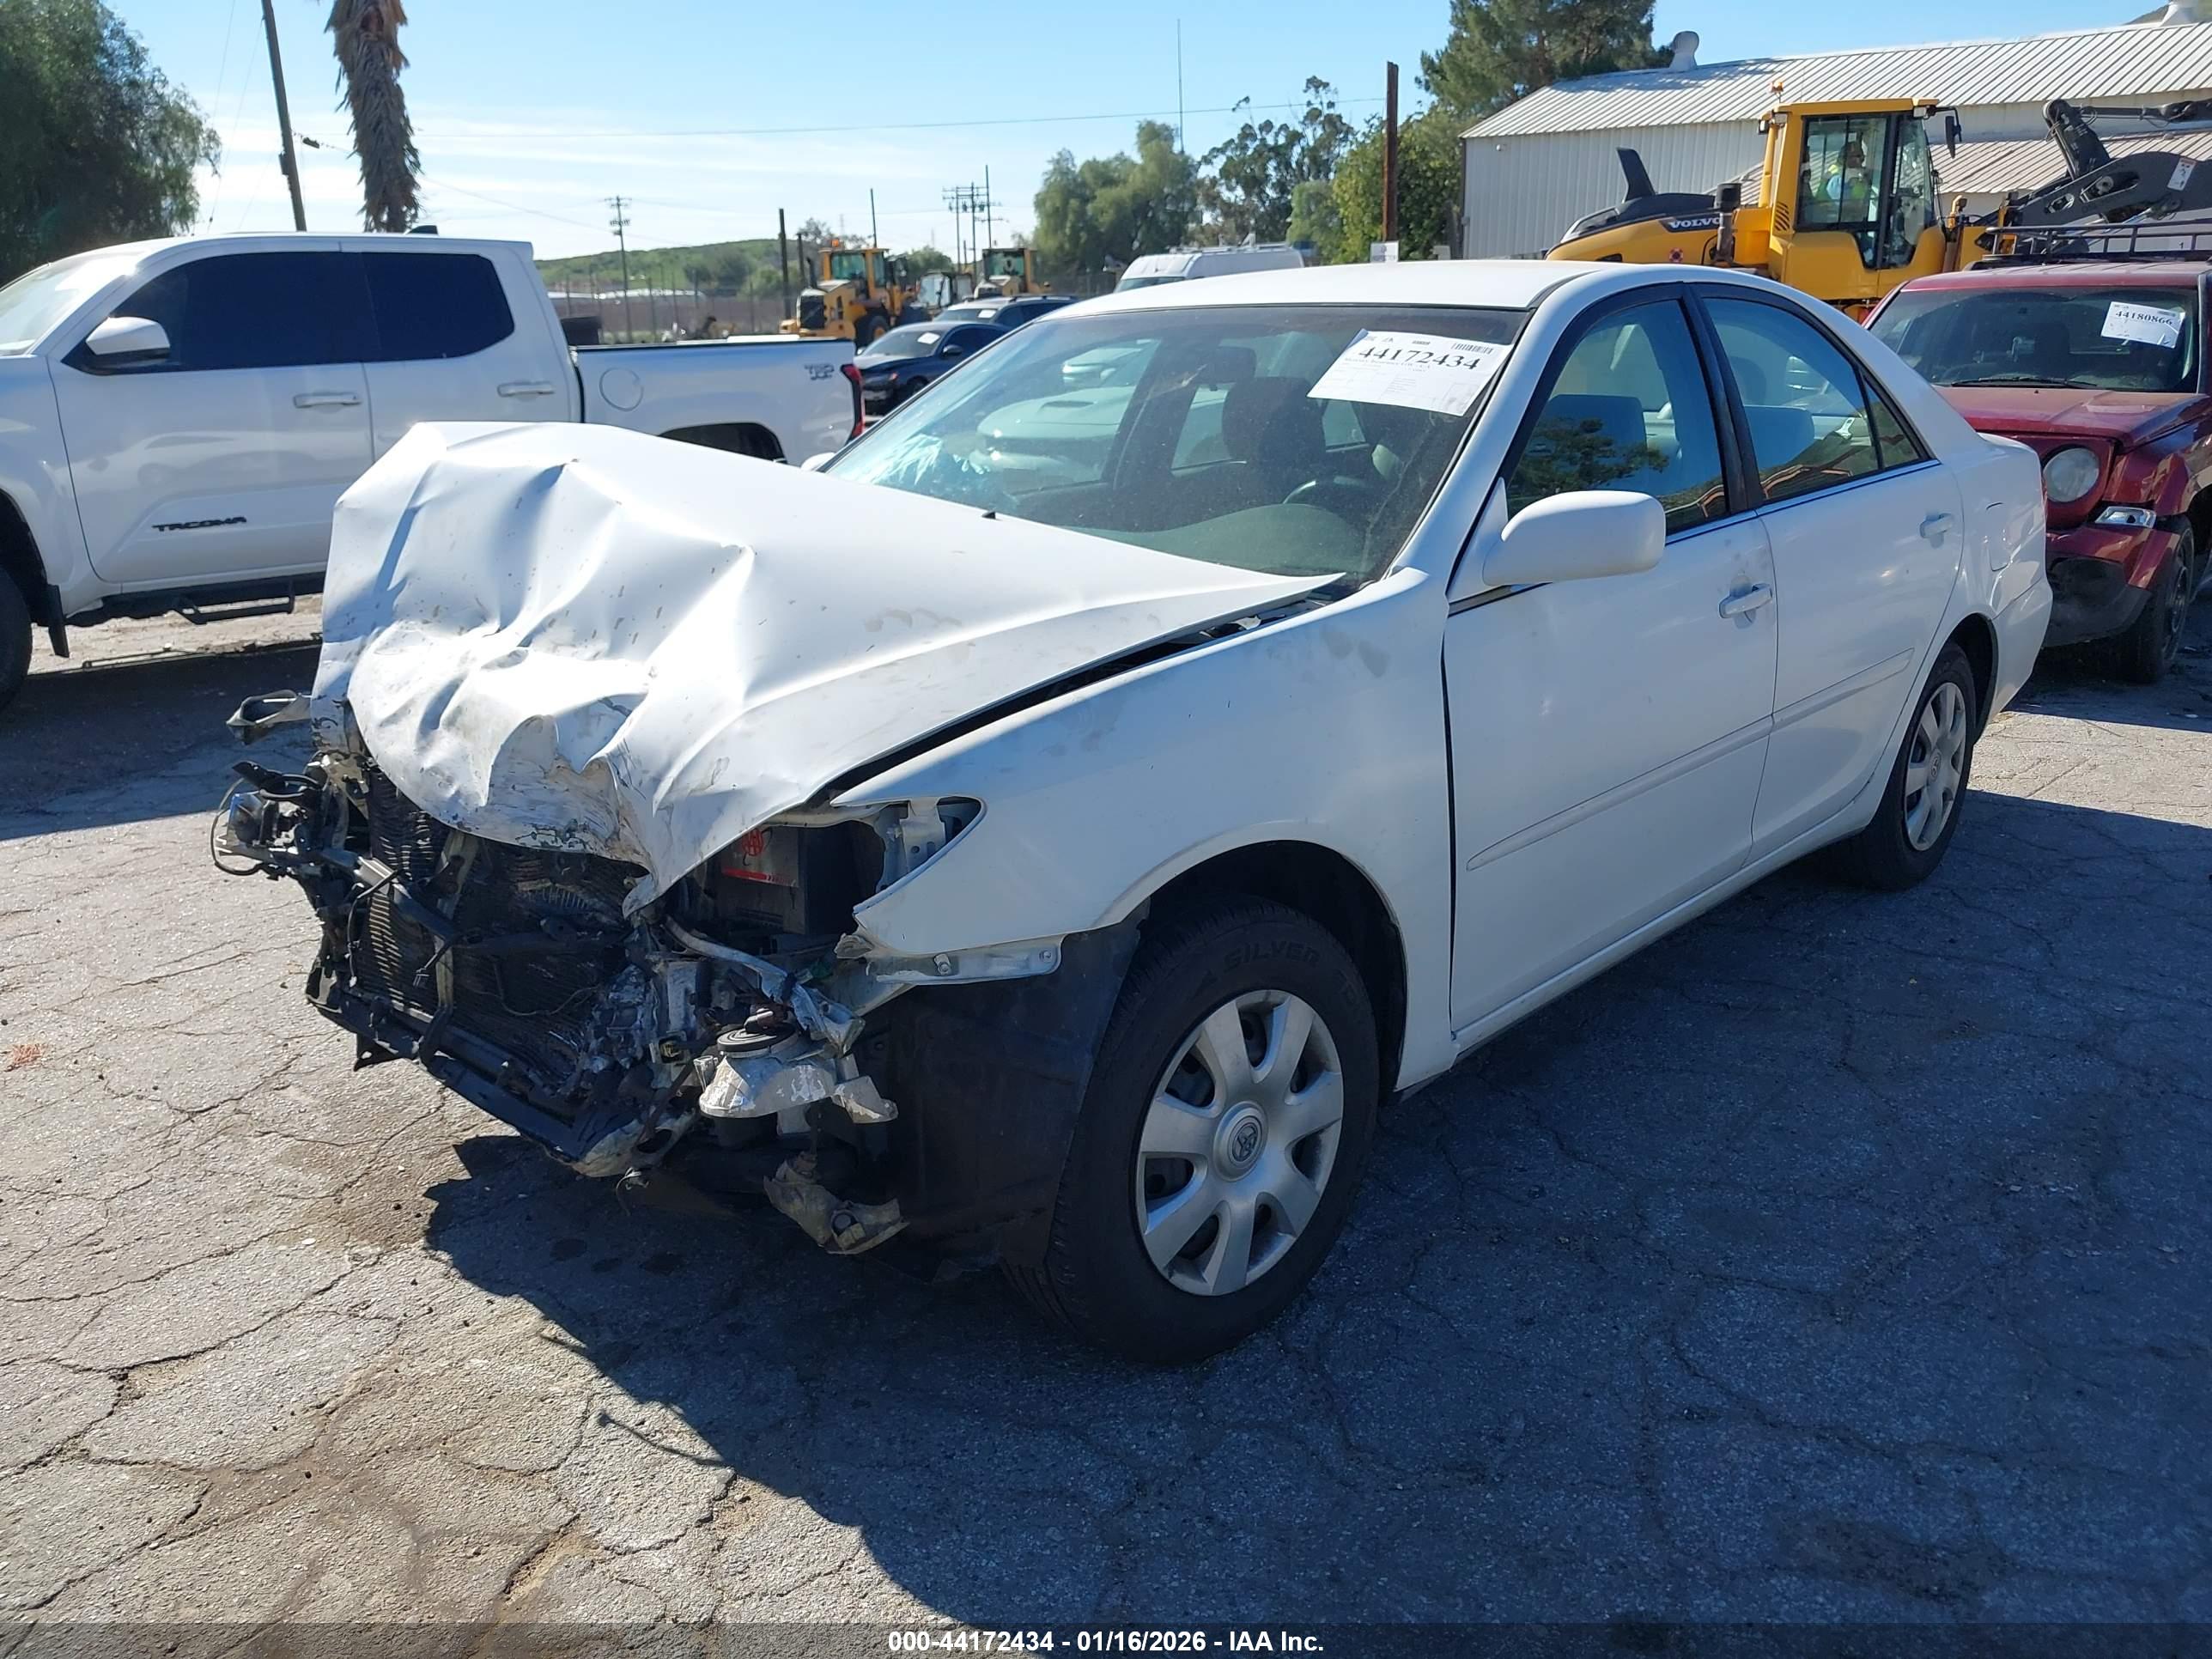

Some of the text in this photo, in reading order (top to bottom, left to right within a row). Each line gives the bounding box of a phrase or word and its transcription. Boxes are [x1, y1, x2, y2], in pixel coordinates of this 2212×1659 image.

[1668, 216, 1721, 229] VOLVO
[2115, 310, 2174, 325] 44180866
[1358, 345, 1482, 370] 44172434
[151, 515, 247, 532] TACOMA
